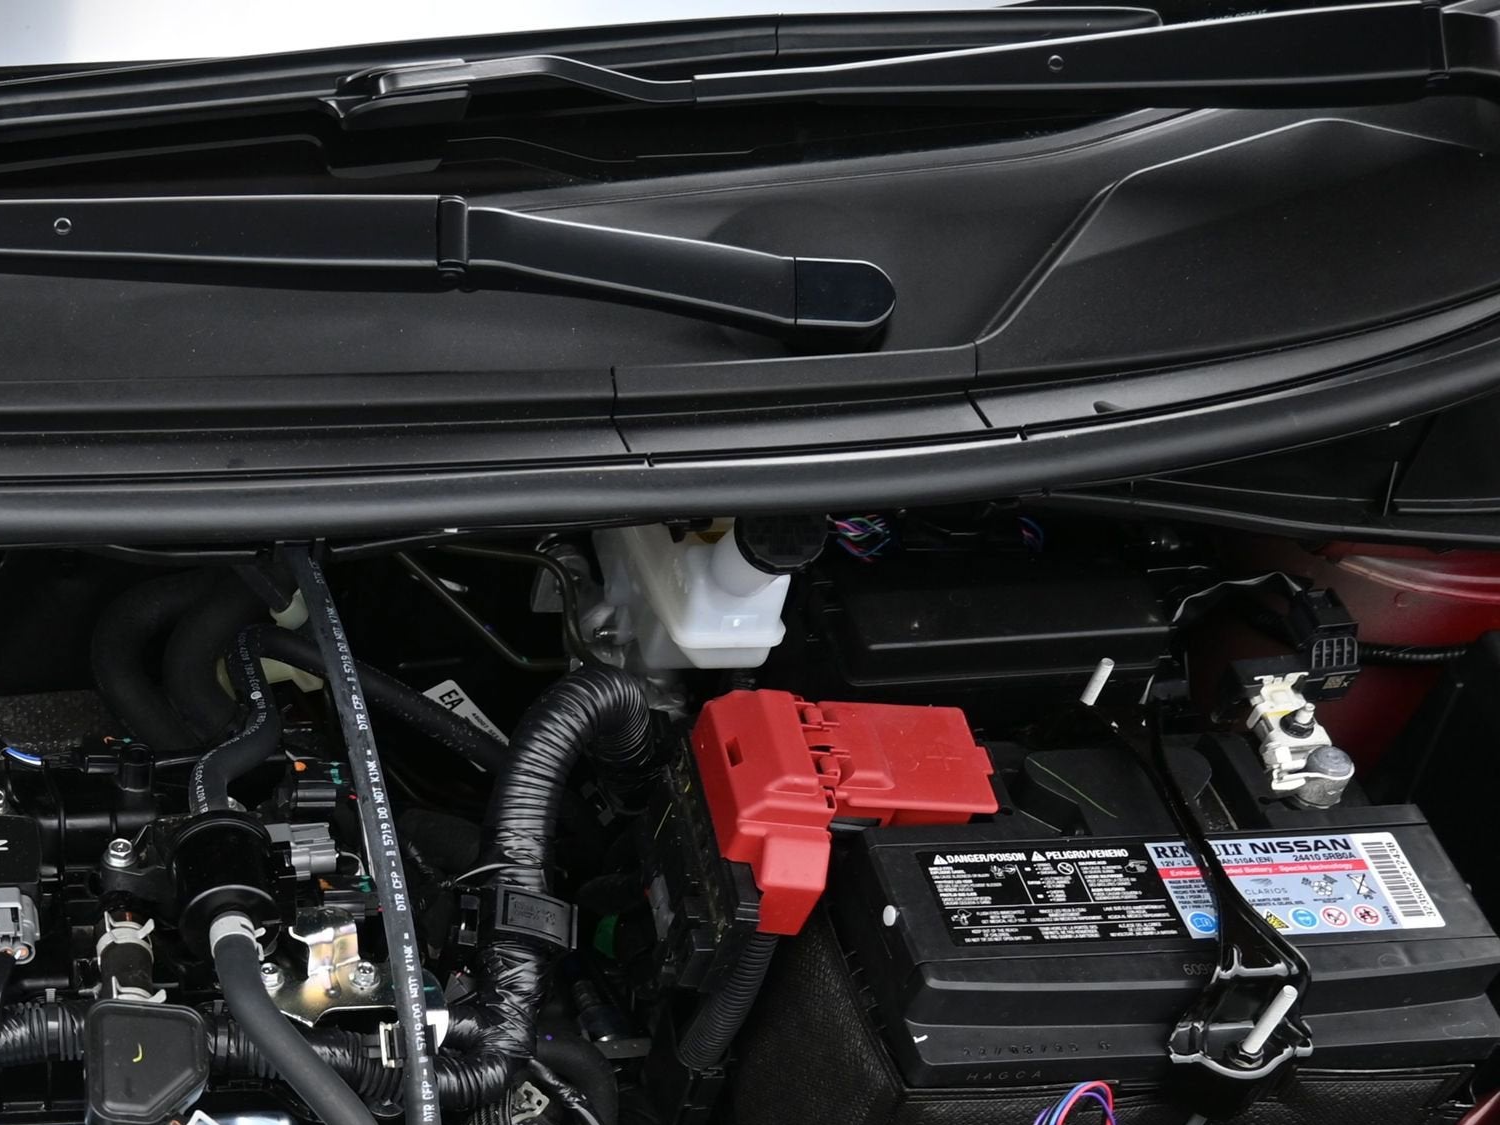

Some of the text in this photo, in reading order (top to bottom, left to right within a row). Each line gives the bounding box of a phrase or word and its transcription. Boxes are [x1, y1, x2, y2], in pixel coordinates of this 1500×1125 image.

[341, 655, 354, 673] 5719
[439, 689, 464, 710] EA
[356, 711, 368, 730] DTR
[366, 760, 380, 783] KINK
[372, 787, 384, 804] NOT
[377, 807, 388, 819] DO
[380, 823, 394, 846] 5719
[1250, 838, 1351, 854] NISSAN
[946, 852, 1026, 864] DANGER/POISON
[1046, 849, 1129, 861] PELIGRO/VENENO
[1293, 853, 1320, 862] 24410
[391, 873, 403, 889] CFP
[1244, 887, 1288, 895] CLARIOS
[394, 893, 406, 911] DTR
